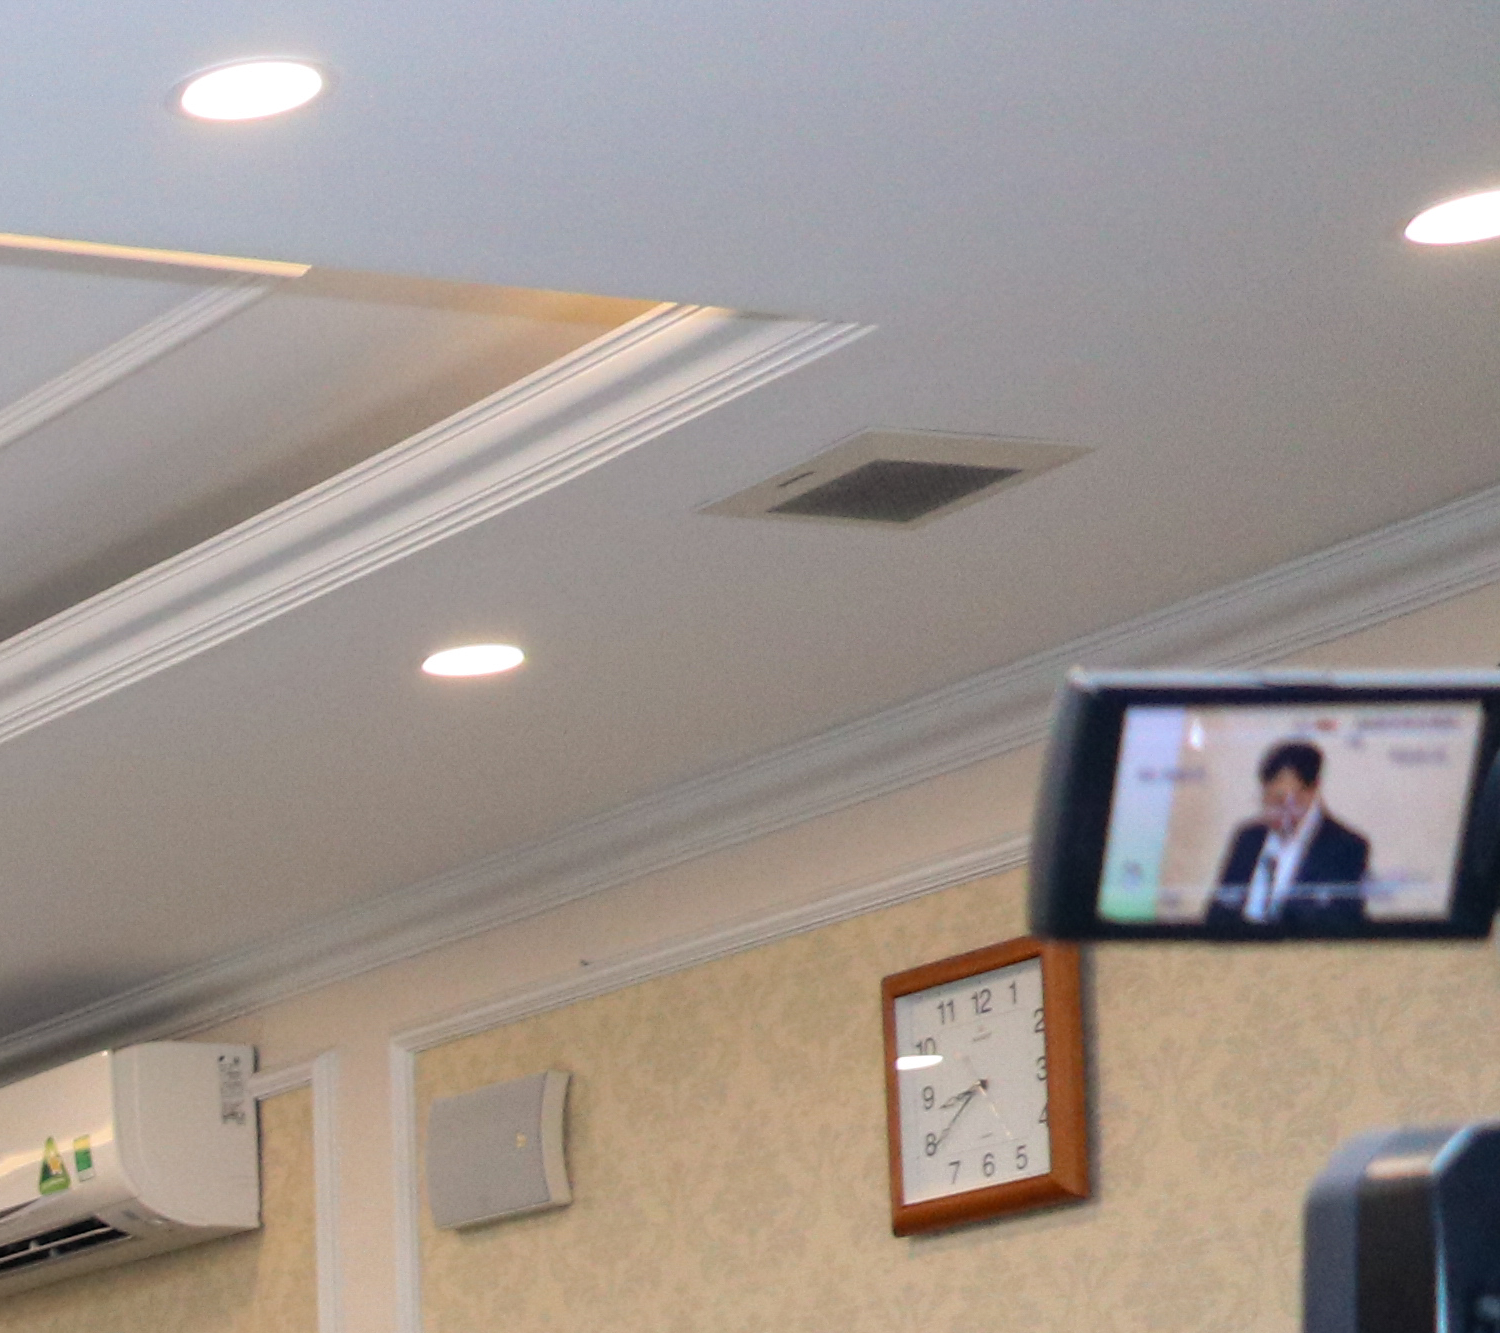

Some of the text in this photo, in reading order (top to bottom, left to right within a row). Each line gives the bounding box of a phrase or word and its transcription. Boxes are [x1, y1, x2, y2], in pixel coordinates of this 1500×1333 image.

[937, 1000, 956, 1024] 11
[971, 988, 993, 1014] 12
[922, 1086, 934, 1110] 9
[925, 1133, 938, 1156] 8
[983, 1153, 996, 1177] 6
[1016, 1144, 1029, 1170] 5
[950, 1161, 962, 1184] 7
